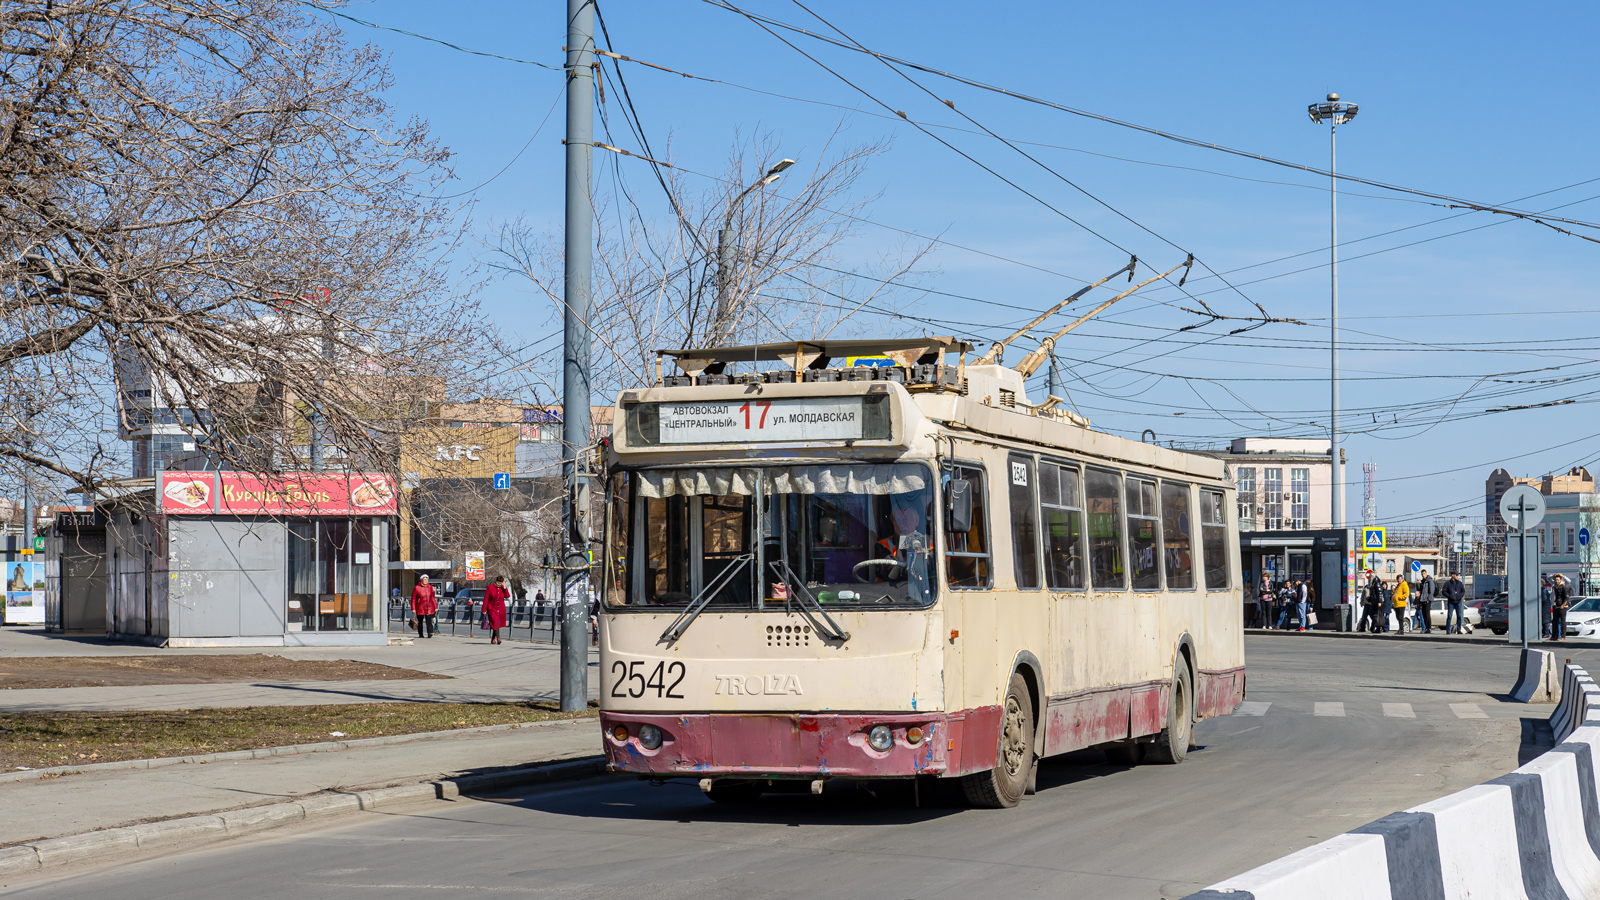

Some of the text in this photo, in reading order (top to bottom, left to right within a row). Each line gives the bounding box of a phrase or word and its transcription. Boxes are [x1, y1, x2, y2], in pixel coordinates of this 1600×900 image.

[673, 405, 729, 416] АВТОВОКЗАЛ
[739, 401, 772, 430] 17
[773, 411, 855, 426] ул. МОЛДАВСКАЯ
[665, 417, 737, 430] «ЦЕНТРАЛЬНЫЙ»
[433, 445, 482, 462] KFC
[1013, 465, 1026, 483] 2542
[611, 660, 686, 699] 2542
[715, 674, 804, 696] TROLZA
